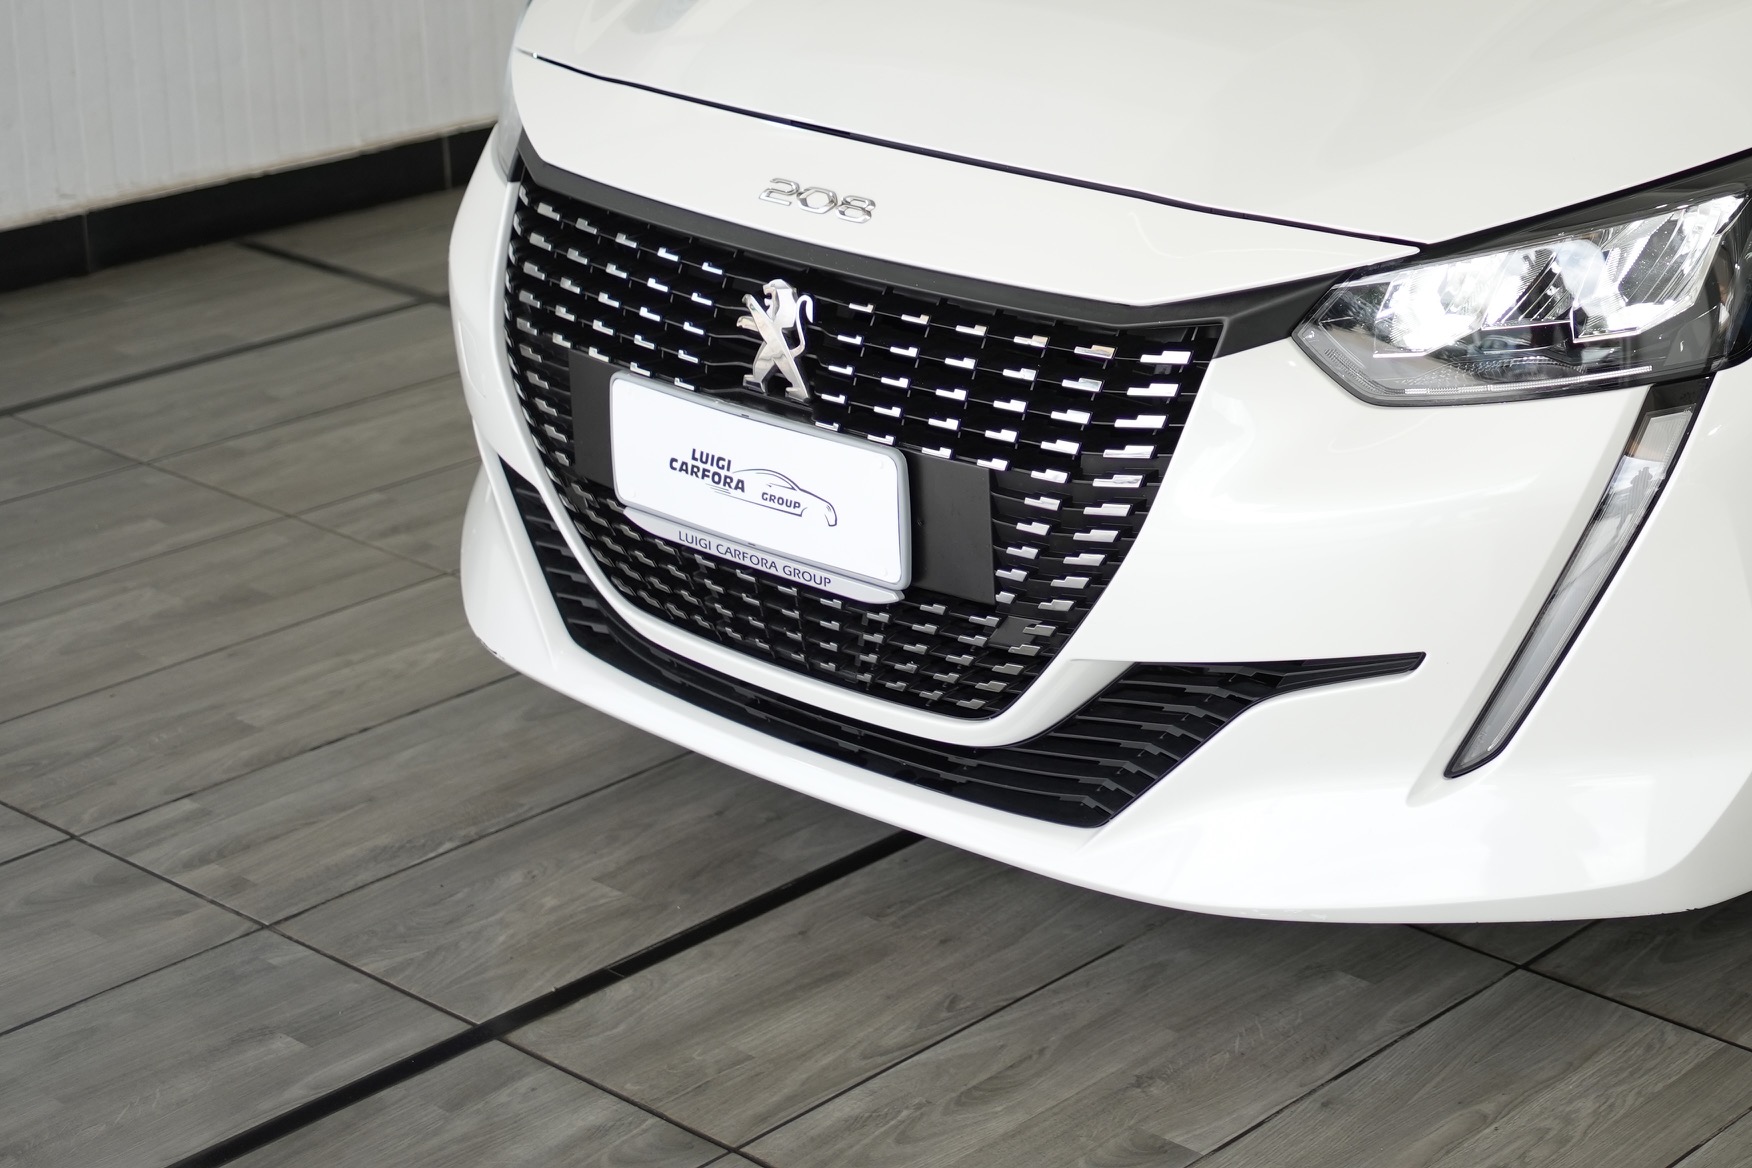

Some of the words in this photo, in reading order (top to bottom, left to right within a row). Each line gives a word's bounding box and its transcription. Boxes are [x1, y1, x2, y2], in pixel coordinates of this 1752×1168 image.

[758, 177, 876, 224] 208
[669, 457, 746, 494] CARFORA
[691, 448, 732, 472] LUIGI
[761, 491, 801, 510] GROUP
[678, 530, 712, 551] LUIGI
[716, 543, 779, 572] CARFORA
[782, 565, 832, 588] GROUP
